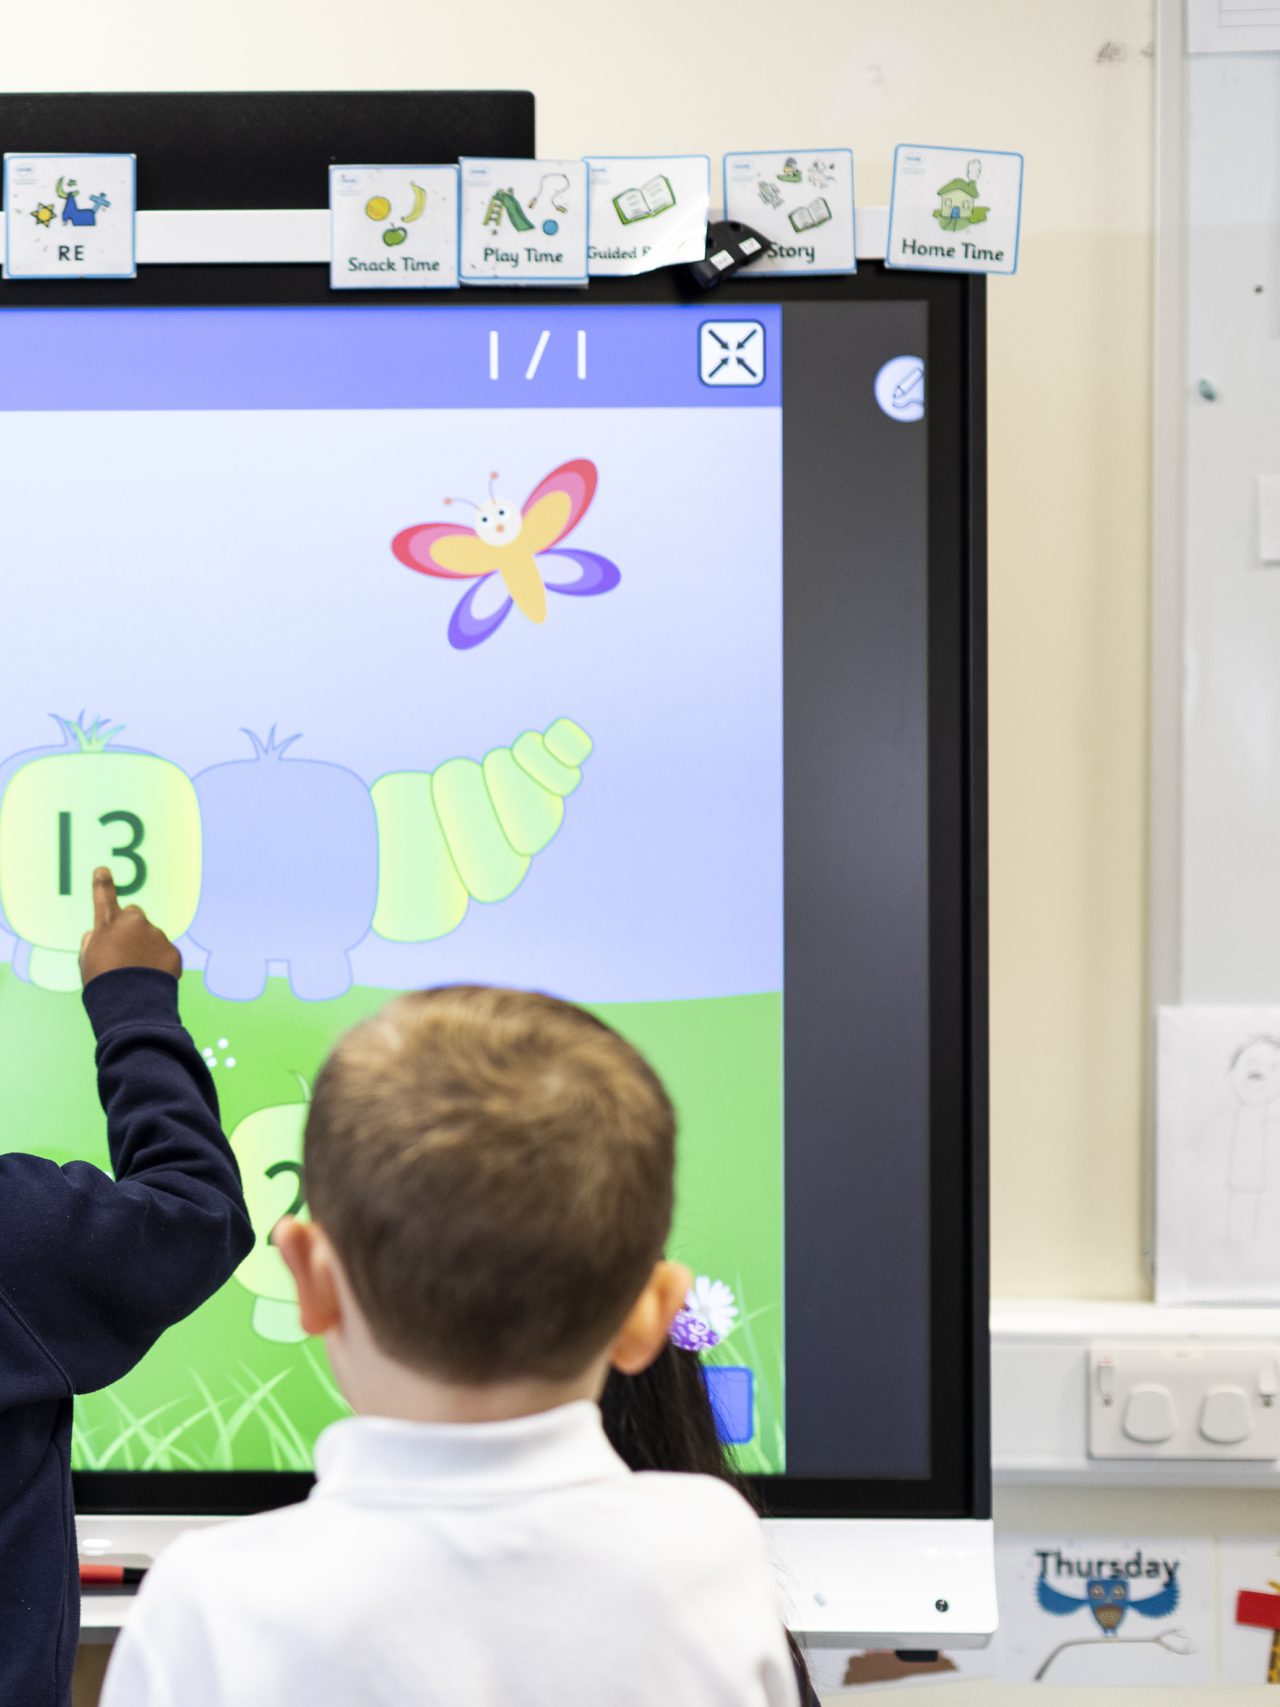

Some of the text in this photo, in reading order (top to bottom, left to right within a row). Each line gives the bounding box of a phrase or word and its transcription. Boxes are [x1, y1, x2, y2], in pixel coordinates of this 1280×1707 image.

[58, 245, 85, 261] RE
[483, 247, 564, 268] Play Time
[588, 245, 637, 260] Guided
[767, 242, 815, 263] Story
[901, 238, 1005, 261] Home Time
[348, 256, 440, 273] Snack Time
[58, 809, 147, 896] 13
[1033, 1548, 1179, 1588] Thursday
